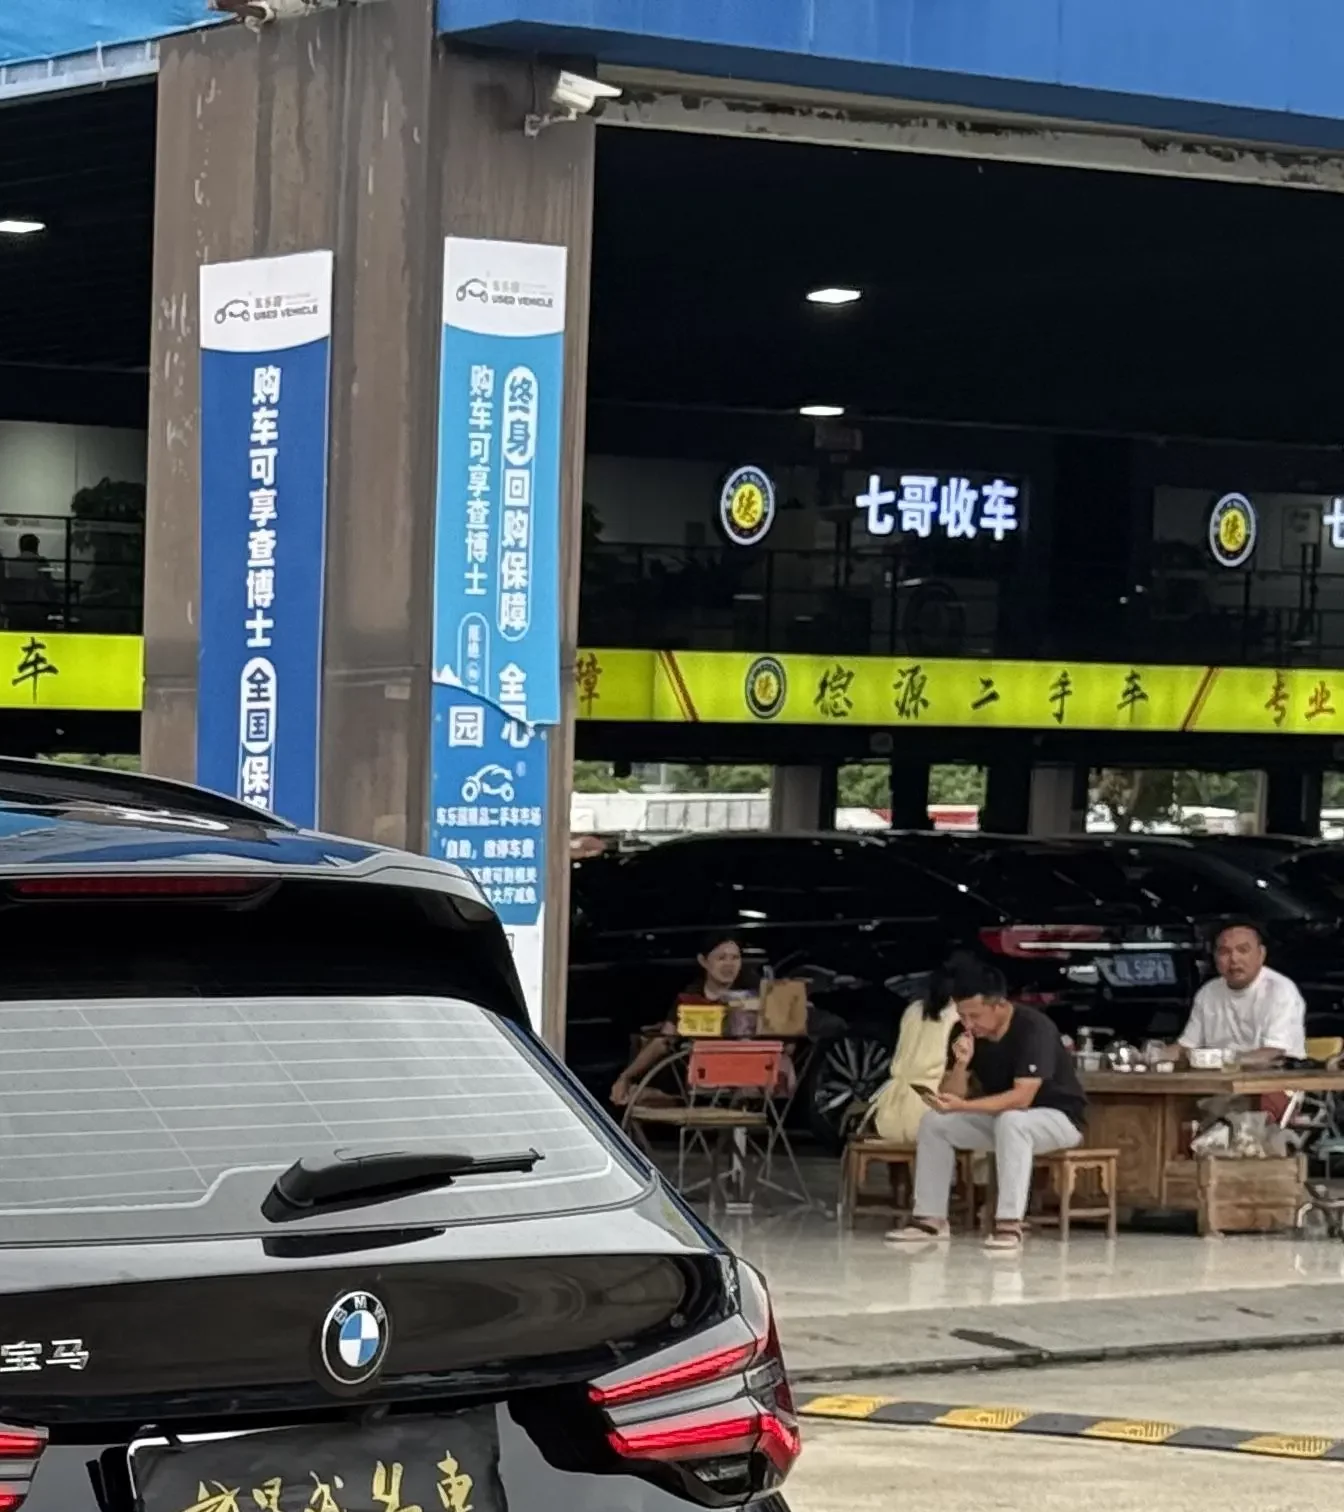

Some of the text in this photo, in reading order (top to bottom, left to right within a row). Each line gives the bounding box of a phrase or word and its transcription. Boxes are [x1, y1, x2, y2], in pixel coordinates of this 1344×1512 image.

[245, 364, 282, 648] 购车可享查博士
[464, 364, 495, 596] 购车可享查博士
[855, 474, 1020, 540] 七哥收车
[333, 1295, 386, 1326] BMW
